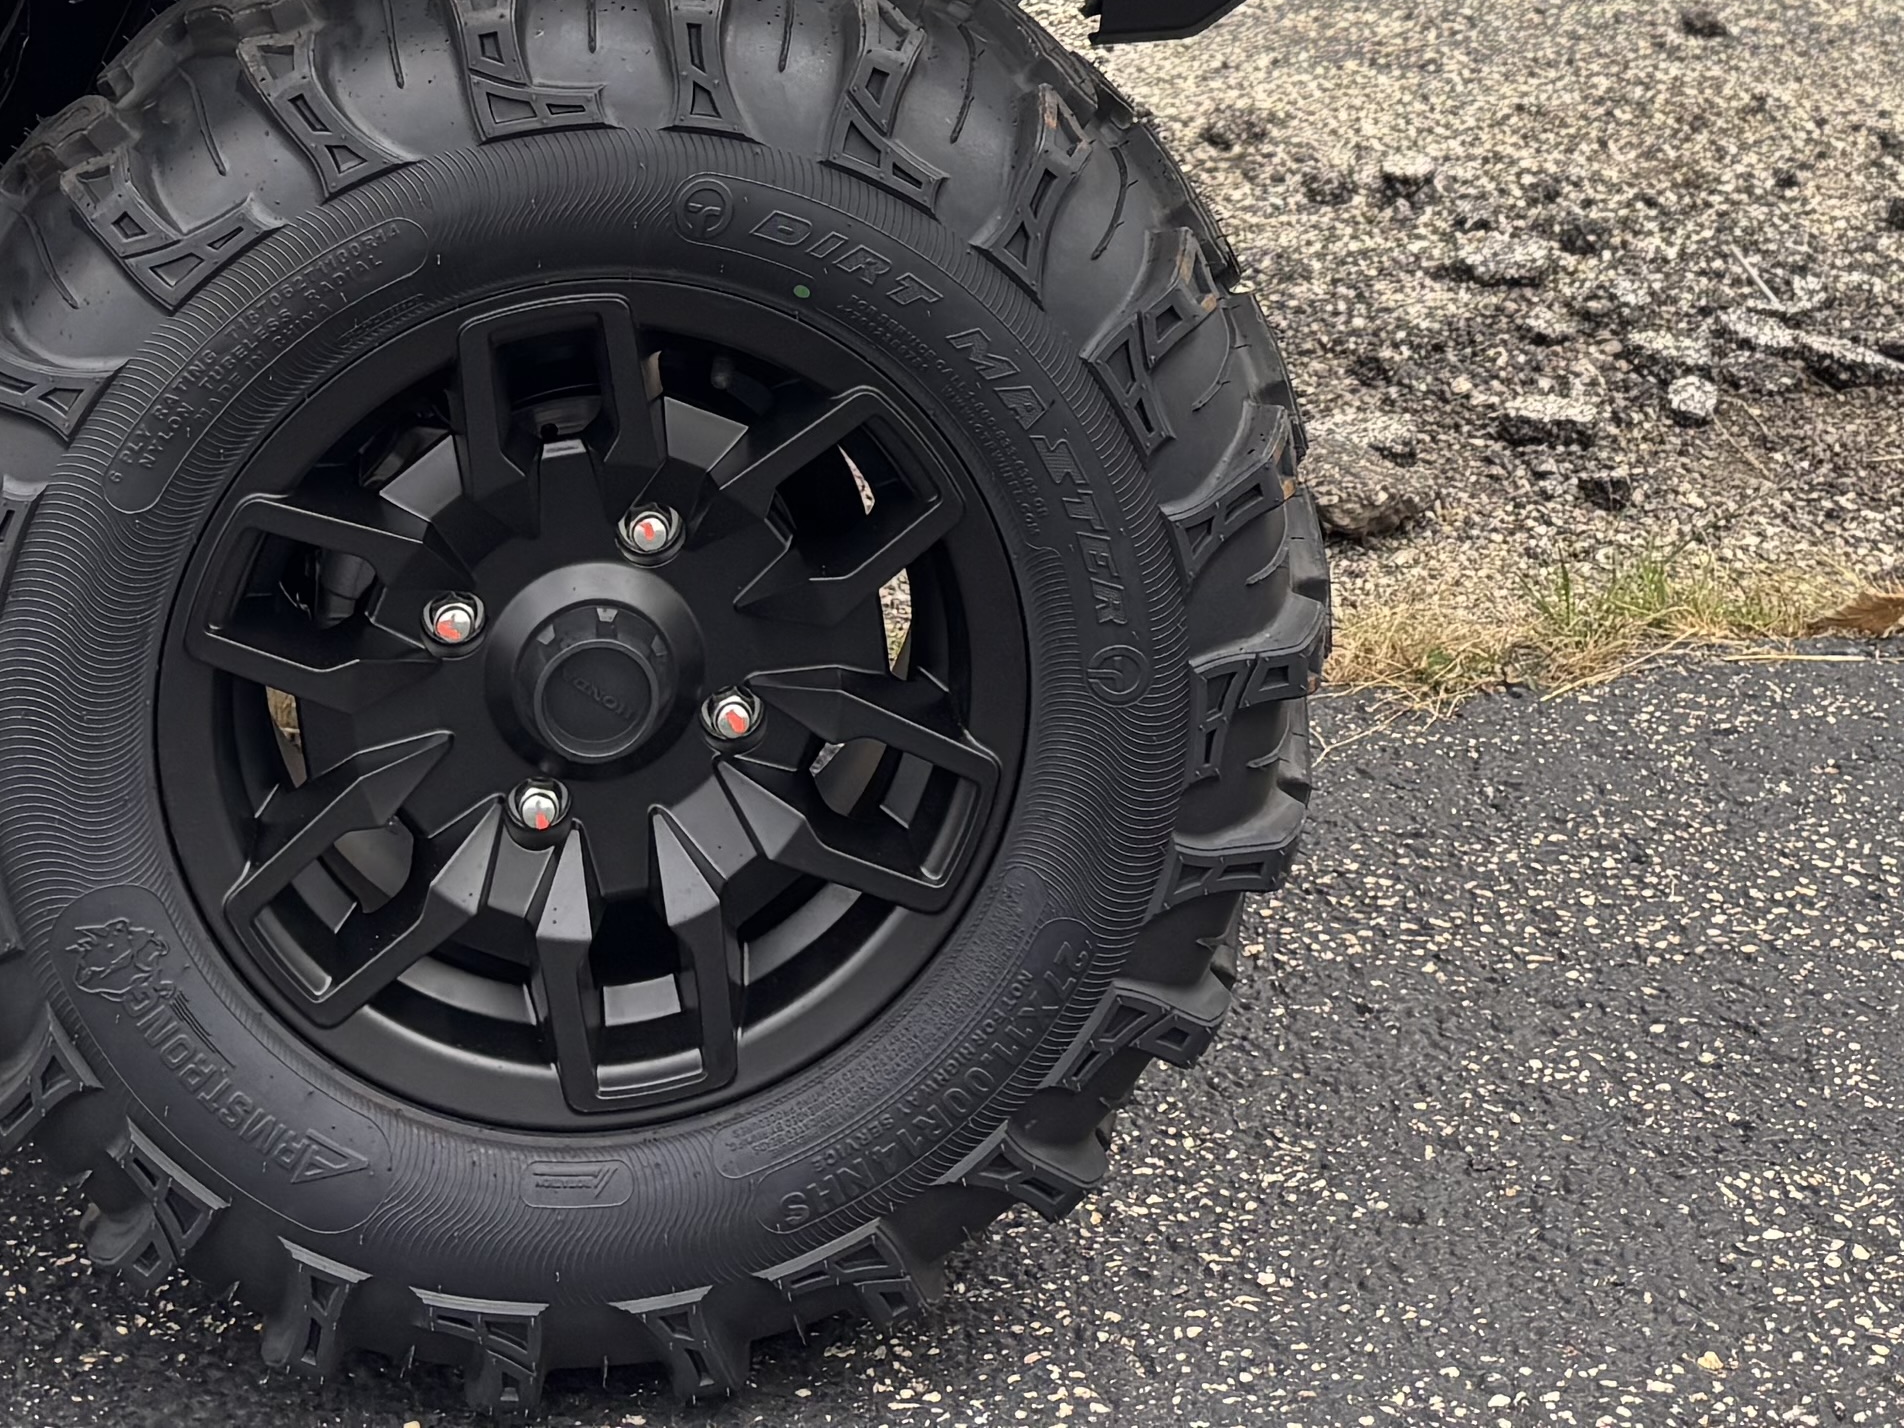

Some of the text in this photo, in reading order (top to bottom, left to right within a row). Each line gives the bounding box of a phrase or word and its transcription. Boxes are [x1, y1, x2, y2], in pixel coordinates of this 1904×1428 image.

[105, 467, 124, 485] 6
[116, 421, 155, 466] PLY
[148, 345, 220, 423] RATING
[136, 398, 197, 471] NYLON
[196, 304, 295, 393] TUBELESS
[301, 249, 384, 306] RADIAL
[192, 370, 245, 426] MADE
[242, 347, 269, 372] IN
[269, 299, 335, 349] CHINA
[749, 209, 1129, 626] DIRT MASTER
[969, 1005, 1008, 1048] FOR
[998, 968, 1036, 1012] NOT
[122, 982, 370, 1185] ARMSTRONG
[893, 1040, 977, 1118] HIGHWAY
[812, 1113, 895, 1173] SERVICE
